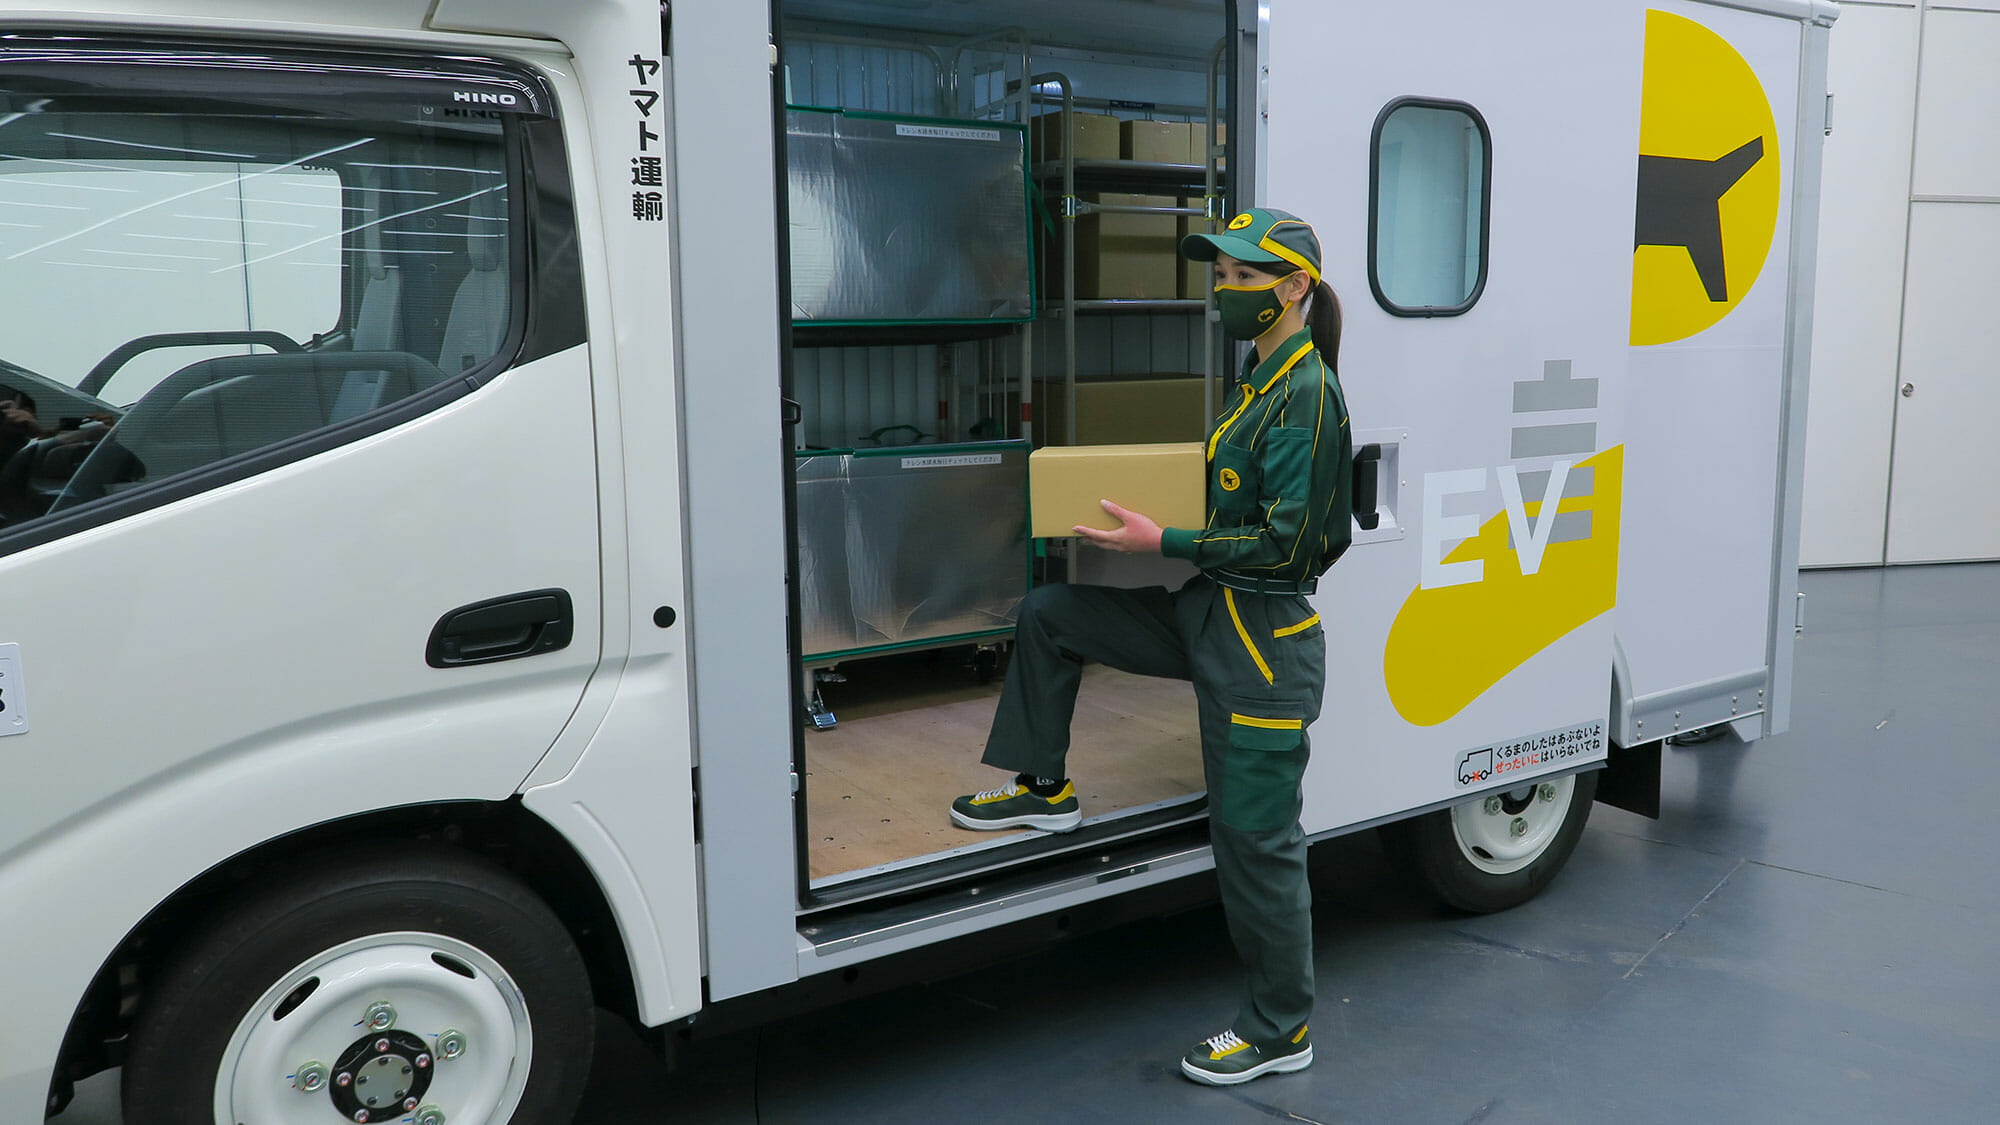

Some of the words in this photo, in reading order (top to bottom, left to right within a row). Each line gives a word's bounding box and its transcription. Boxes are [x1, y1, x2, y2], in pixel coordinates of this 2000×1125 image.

[453, 91, 516, 105] HINO
[628, 54, 664, 222] ヤマト運輸
[1420, 460, 1572, 590] EV
[1495, 738, 1601, 774] ぜったいにはいらないでね
[1496, 724, 1601, 759] くるまのしたはあぶないよ
